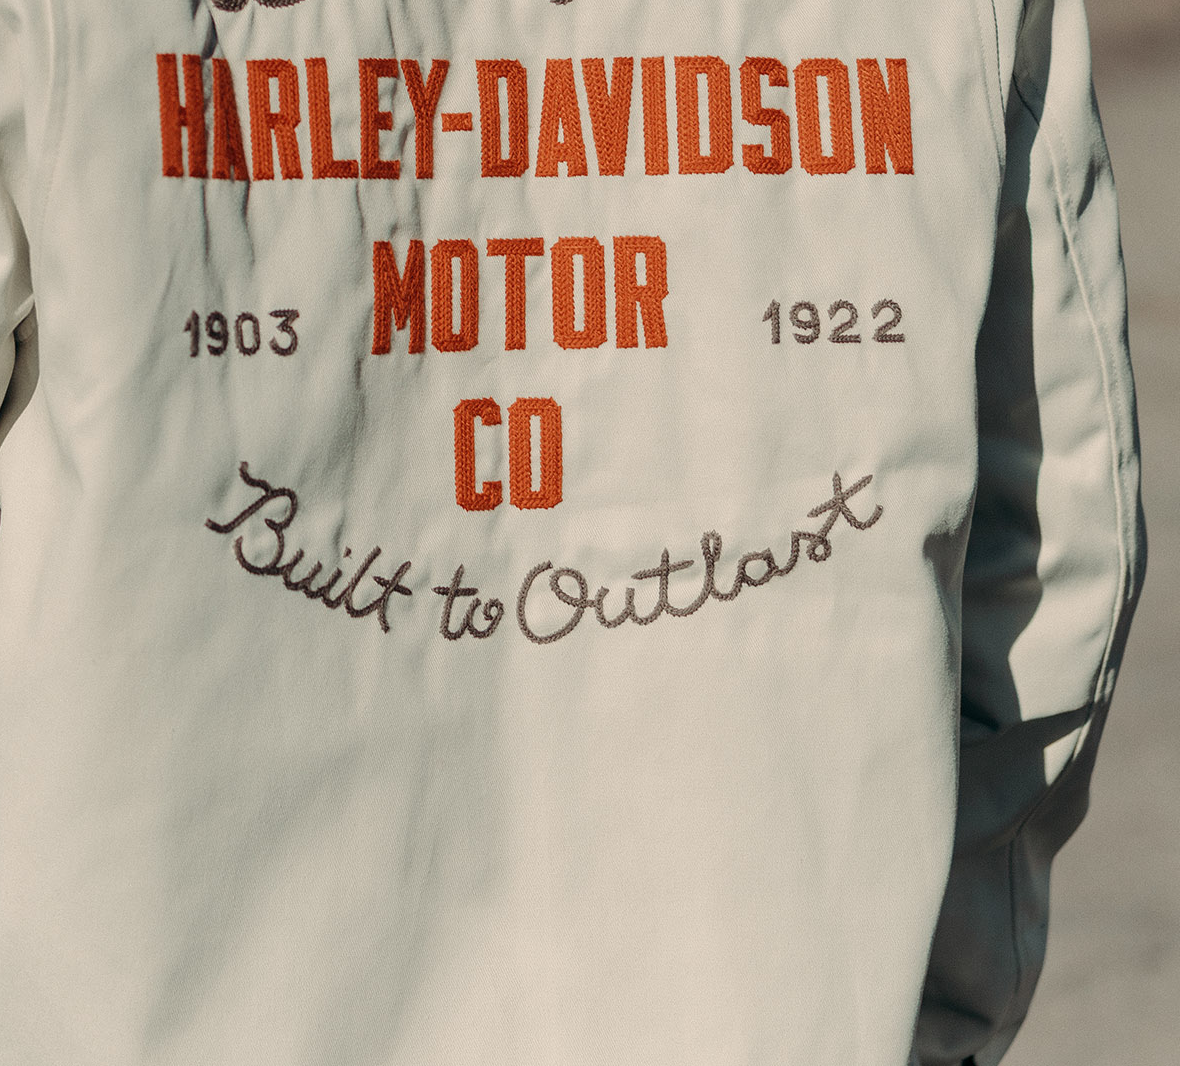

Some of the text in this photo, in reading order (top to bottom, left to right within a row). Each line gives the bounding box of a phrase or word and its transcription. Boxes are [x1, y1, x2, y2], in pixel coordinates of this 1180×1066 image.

[156, 53, 915, 182] HARLEY-DAVIDSON
[184, 308, 300, 357] 1903
[371, 235, 669, 355] MOTOR
[762, 299, 905, 344] 1922
[452, 396, 563, 512] CO
[206, 461, 884, 645] Built to Outlast
